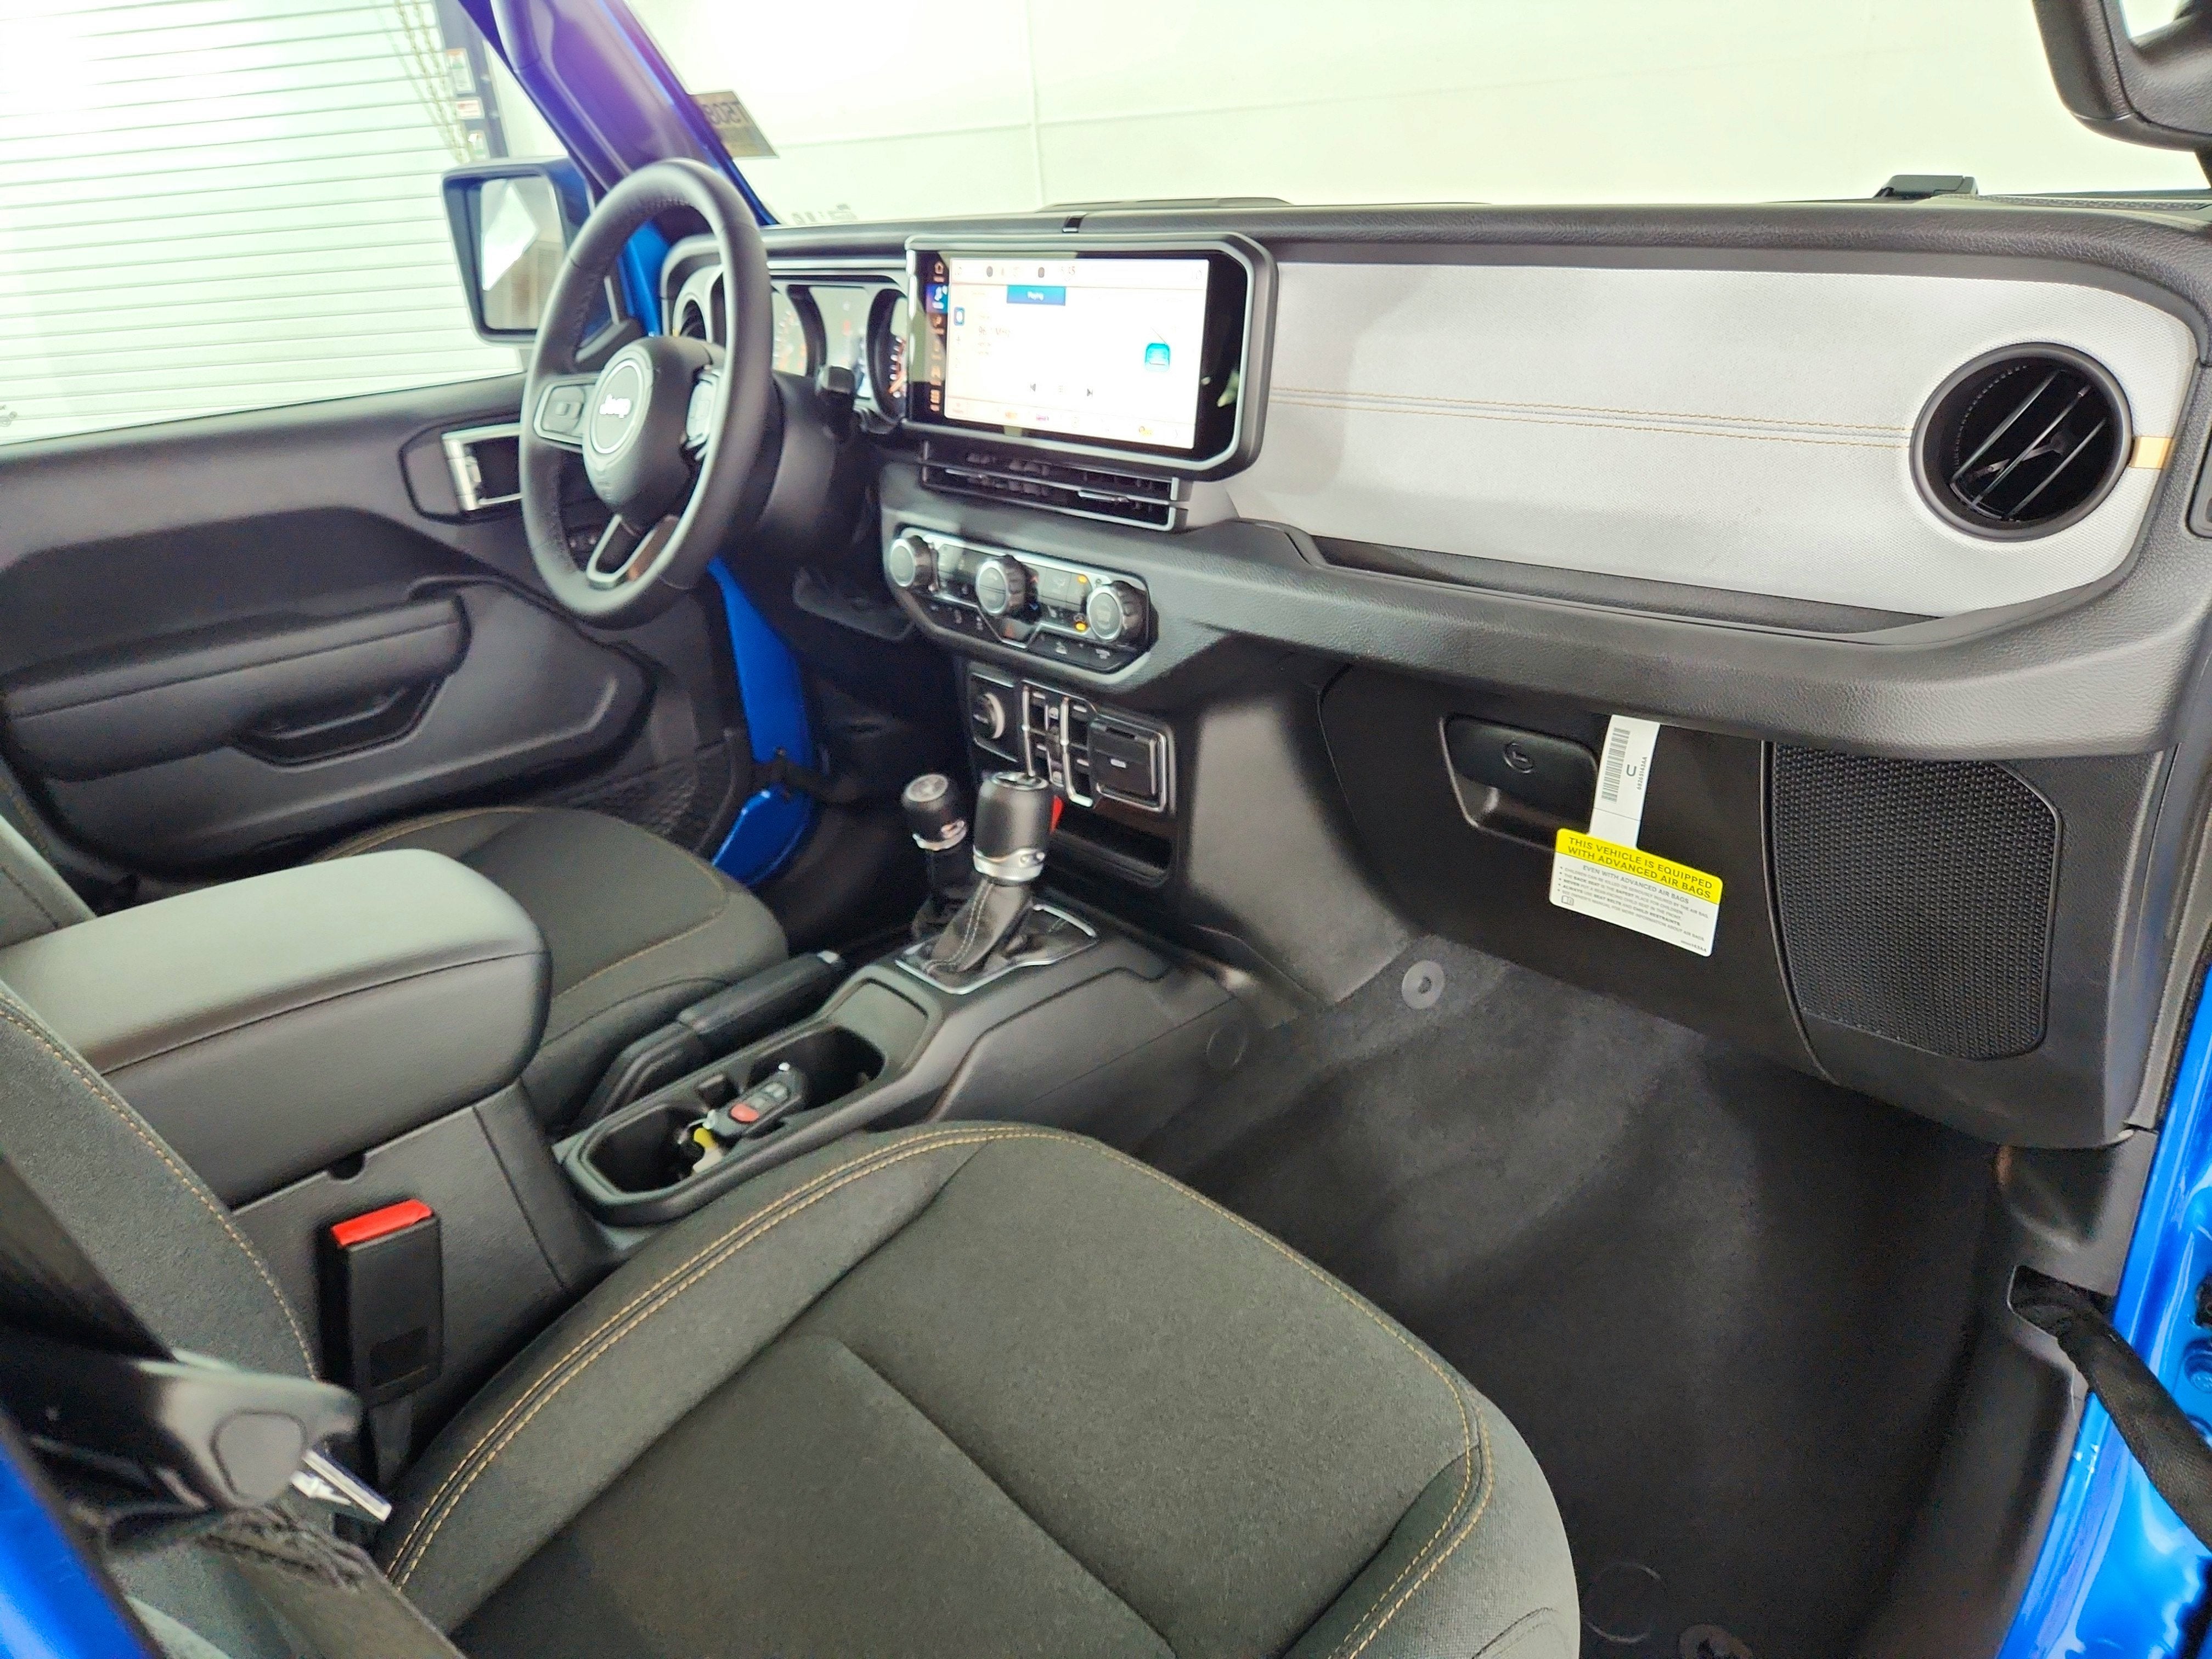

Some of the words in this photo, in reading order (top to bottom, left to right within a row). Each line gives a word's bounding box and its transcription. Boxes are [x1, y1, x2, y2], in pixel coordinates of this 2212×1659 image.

[599, 393, 631, 419] Jeep
[1627, 764, 1636, 776] U
[1567, 845, 1594, 860] WITH
[1598, 855, 1657, 879] ADVANCED
[1660, 874, 1678, 887] AIR
[1681, 882, 1711, 898] BAGS
[1568, 837, 1592, 850] THIS
[1595, 844, 1641, 864] VEHICLE
[1644, 859, 1654, 868] IS
[1658, 864, 1712, 889] EQUIPPED
[1583, 865, 1599, 874] EVEN
[1601, 871, 1618, 880] WITH
[1621, 877, 1656, 892] ADVANCED
[1658, 888, 1669, 896] AIR
[1671, 893, 1689, 904] BAGS
